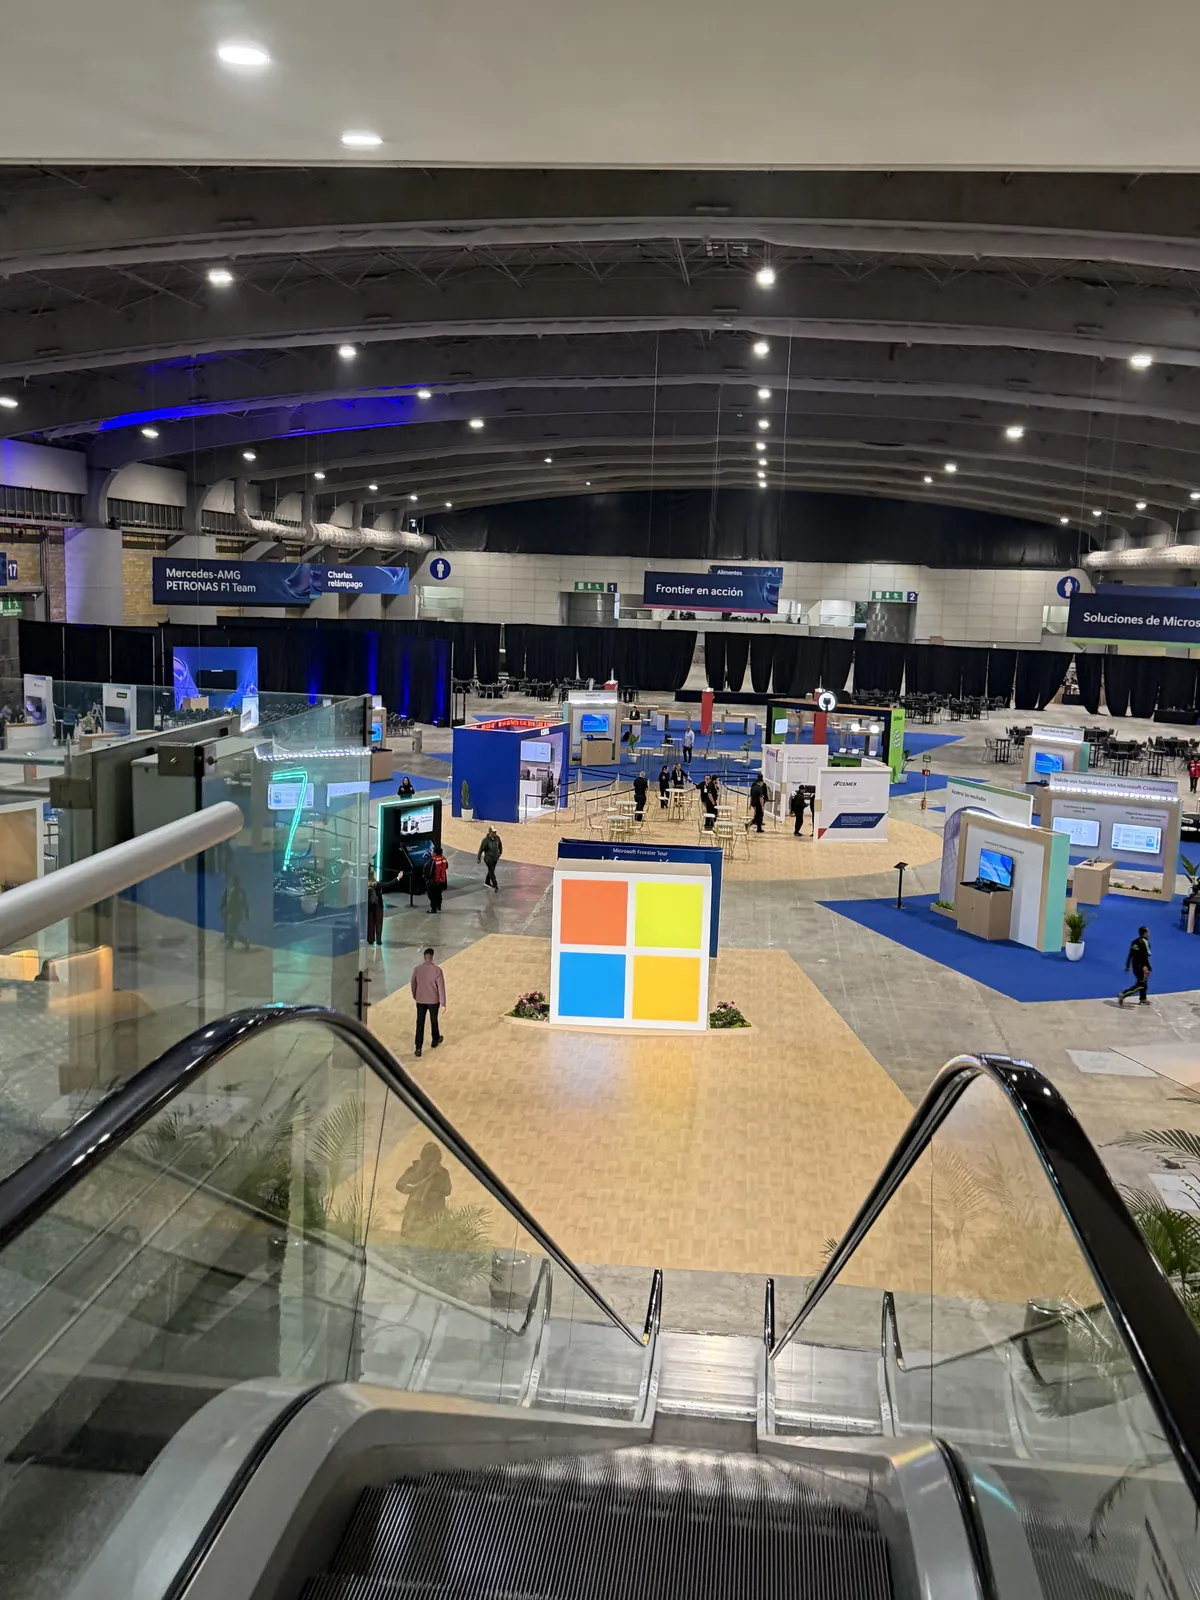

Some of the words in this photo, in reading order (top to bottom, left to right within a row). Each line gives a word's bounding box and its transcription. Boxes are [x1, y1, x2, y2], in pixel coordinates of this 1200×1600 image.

[8, 563, 17, 577] 17
[166, 568, 241, 580] Mercedes-AMG
[327, 570, 353, 580] Charlas
[166, 581, 219, 592] PETRONAS
[220, 582, 230, 592] F1
[232, 582, 256, 593] Team
[327, 579, 364, 590] relámpago
[610, 584, 614, 592] 1
[655, 583, 695, 595] Frontier
[696, 586, 709, 596] en
[710, 585, 743, 597] acción
[909, 592, 916, 601] 2
[1083, 612, 1144, 625] Soluciones
[1146, 615, 1160, 626] de
[1162, 616, 1200, 628] Micros
[612, 847, 636, 855] Microsoft
